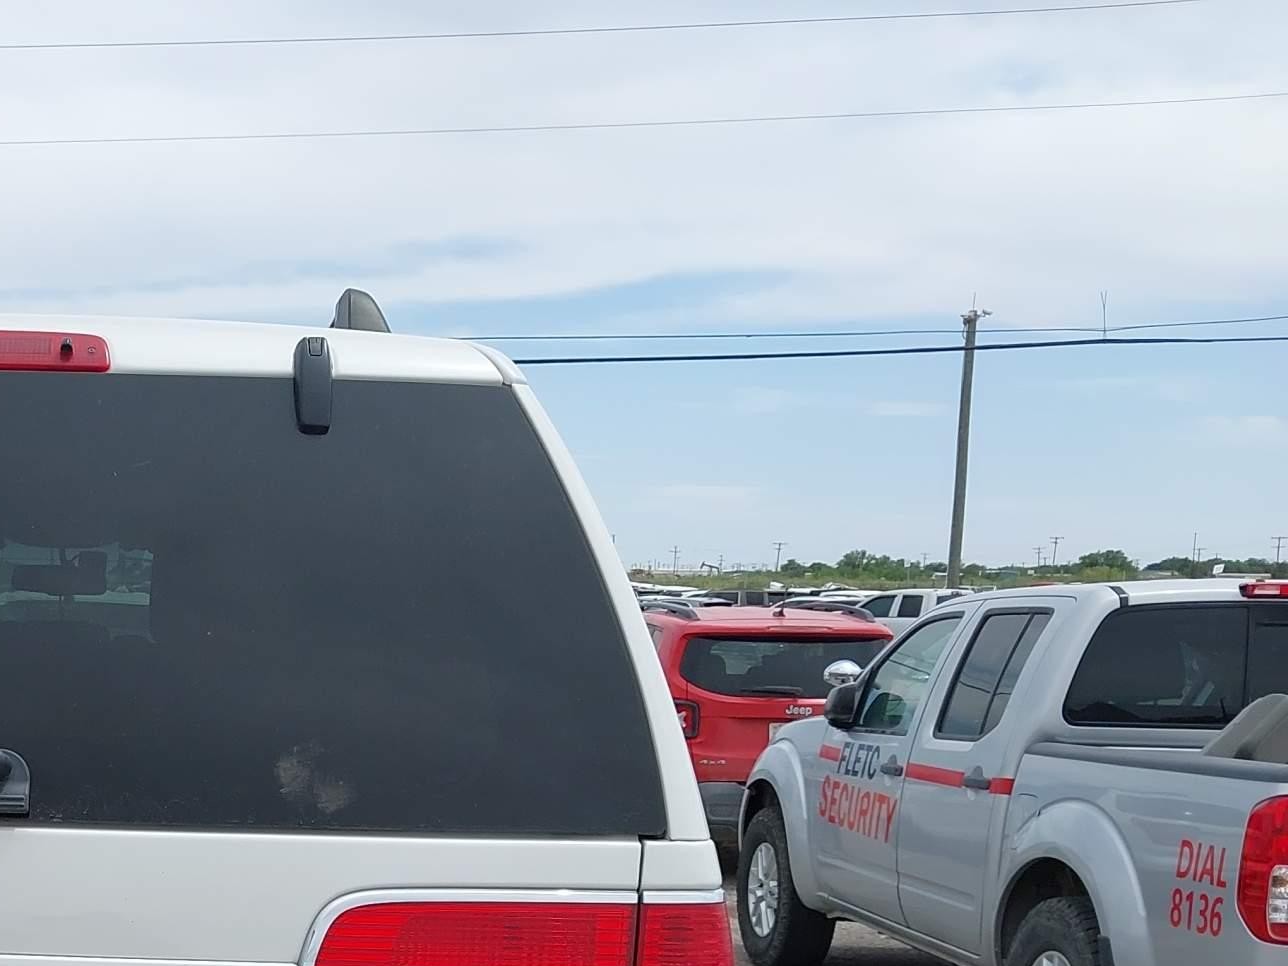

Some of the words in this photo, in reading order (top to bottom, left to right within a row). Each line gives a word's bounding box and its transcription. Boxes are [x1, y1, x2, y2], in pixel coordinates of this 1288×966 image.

[785, 704, 813, 716] Jeep
[837, 742, 880, 779] FLETC
[818, 775, 898, 843] SECURITY
[1175, 839, 1227, 888] DIAL
[1169, 887, 1225, 937] 8136
